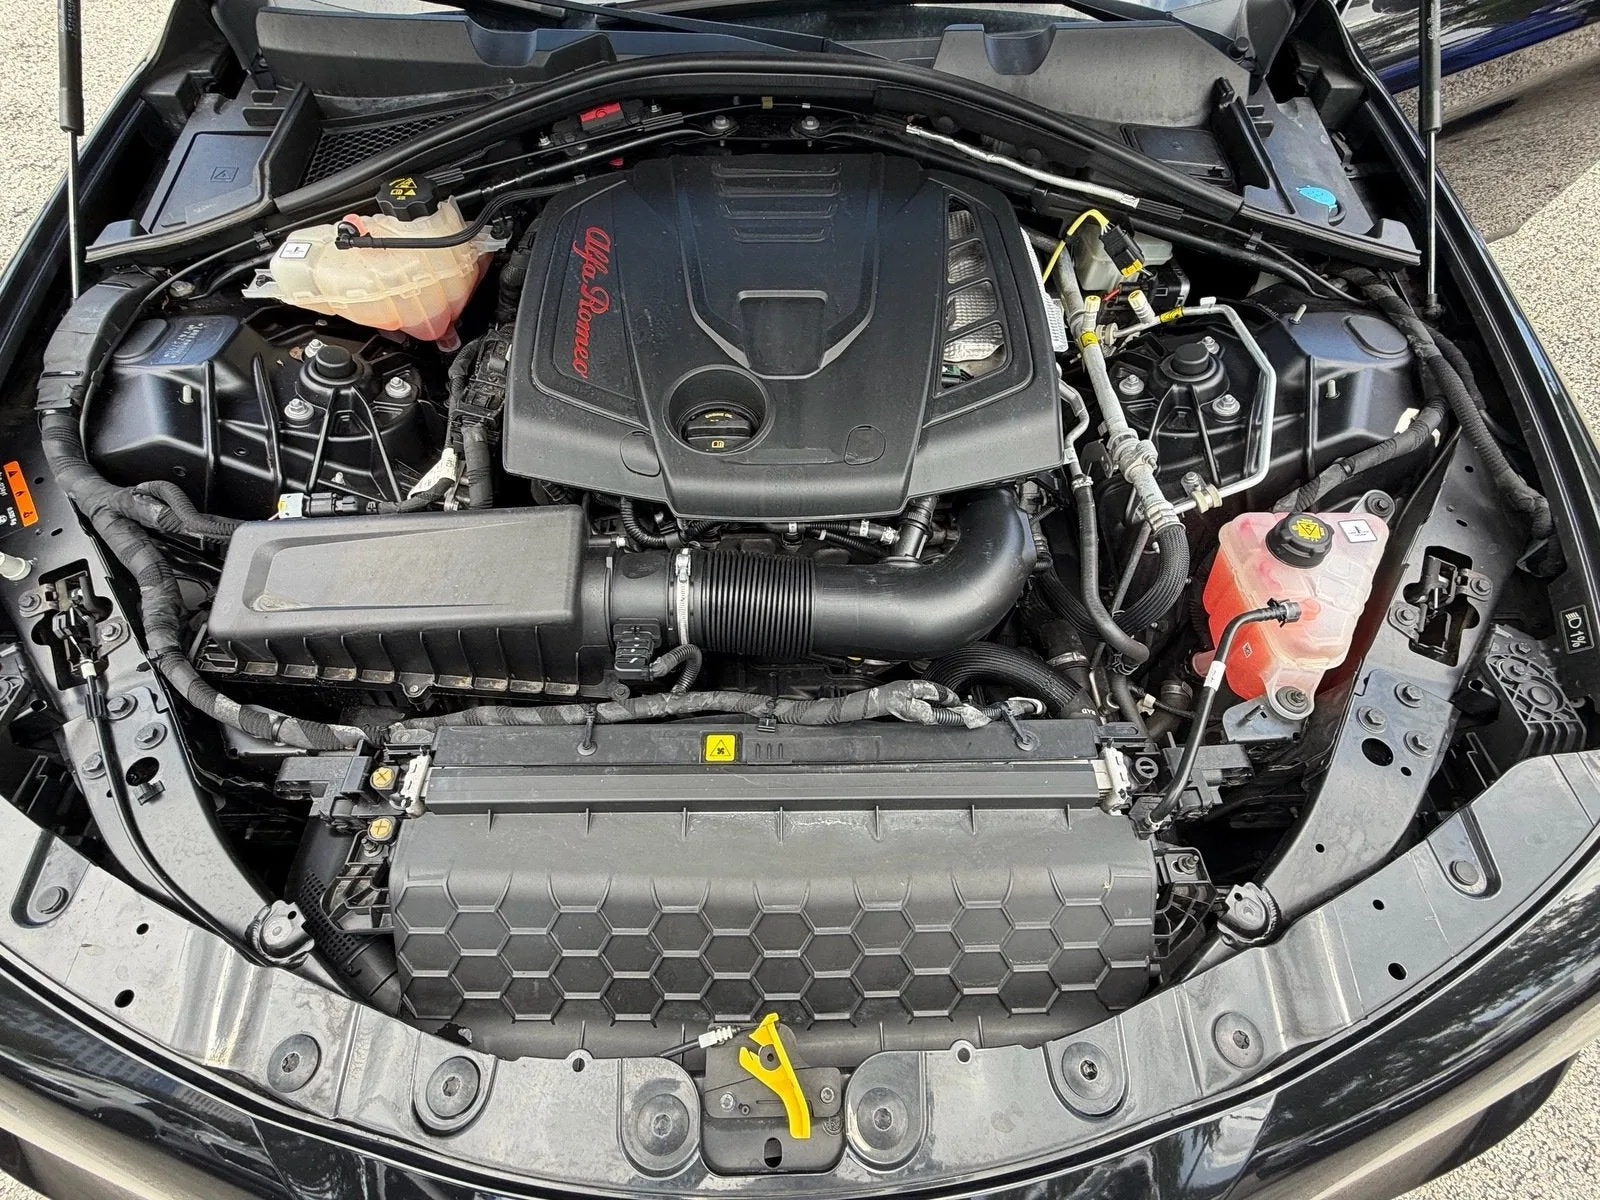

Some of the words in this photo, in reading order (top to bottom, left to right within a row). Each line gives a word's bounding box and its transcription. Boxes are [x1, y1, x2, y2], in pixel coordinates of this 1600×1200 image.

[572, 226, 611, 284] Alfa
[573, 284, 610, 379] Romeo
[1569, 630, 1587, 648] 1%
